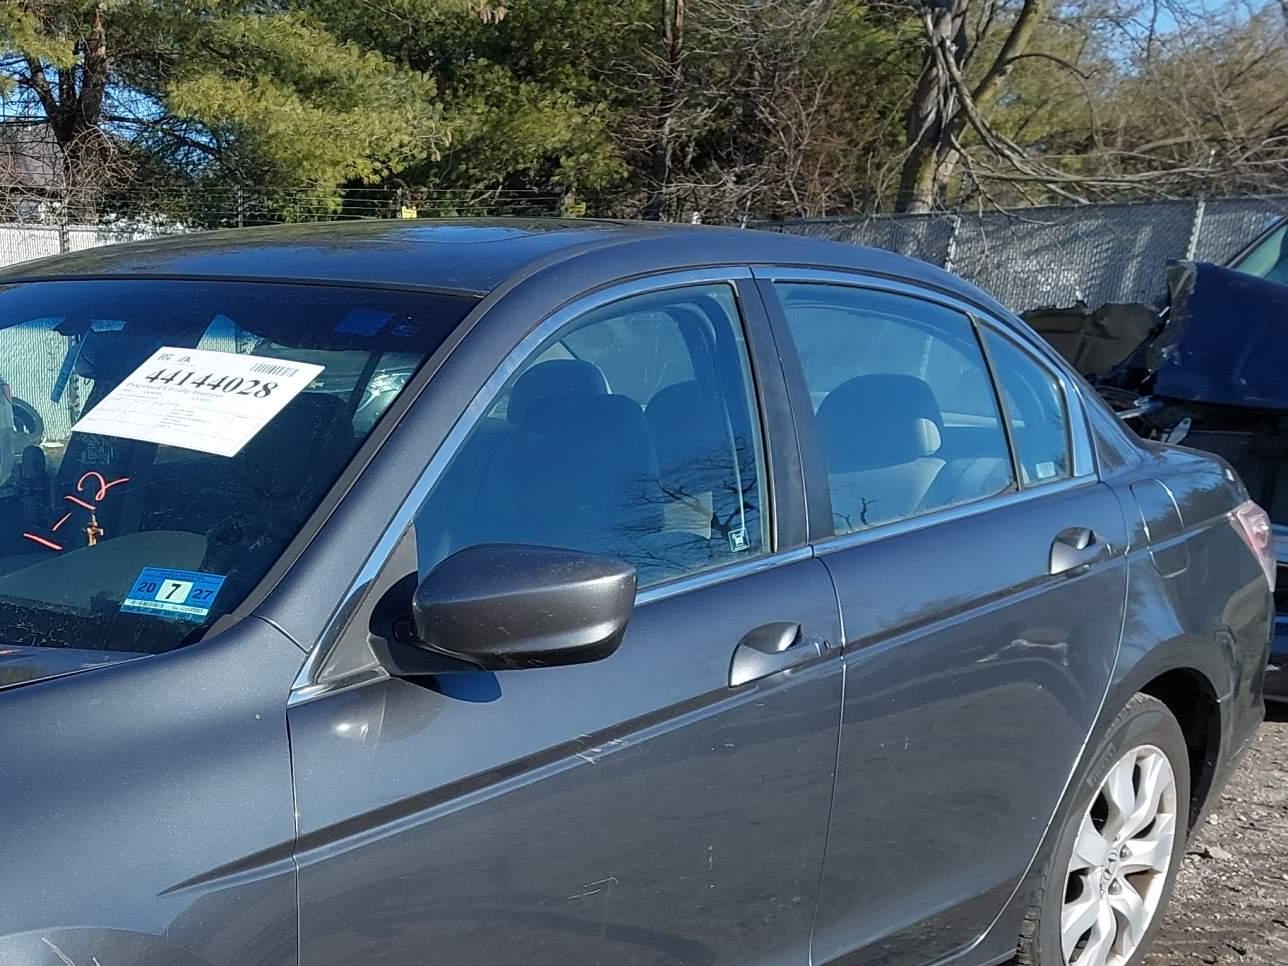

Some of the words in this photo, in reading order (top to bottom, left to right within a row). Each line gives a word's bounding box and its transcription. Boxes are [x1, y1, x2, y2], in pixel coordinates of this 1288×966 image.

[145, 368, 278, 398] 44144028
[136, 581, 156, 593] 20
[165, 583, 181, 599] 7
[192, 588, 214, 600] 27
